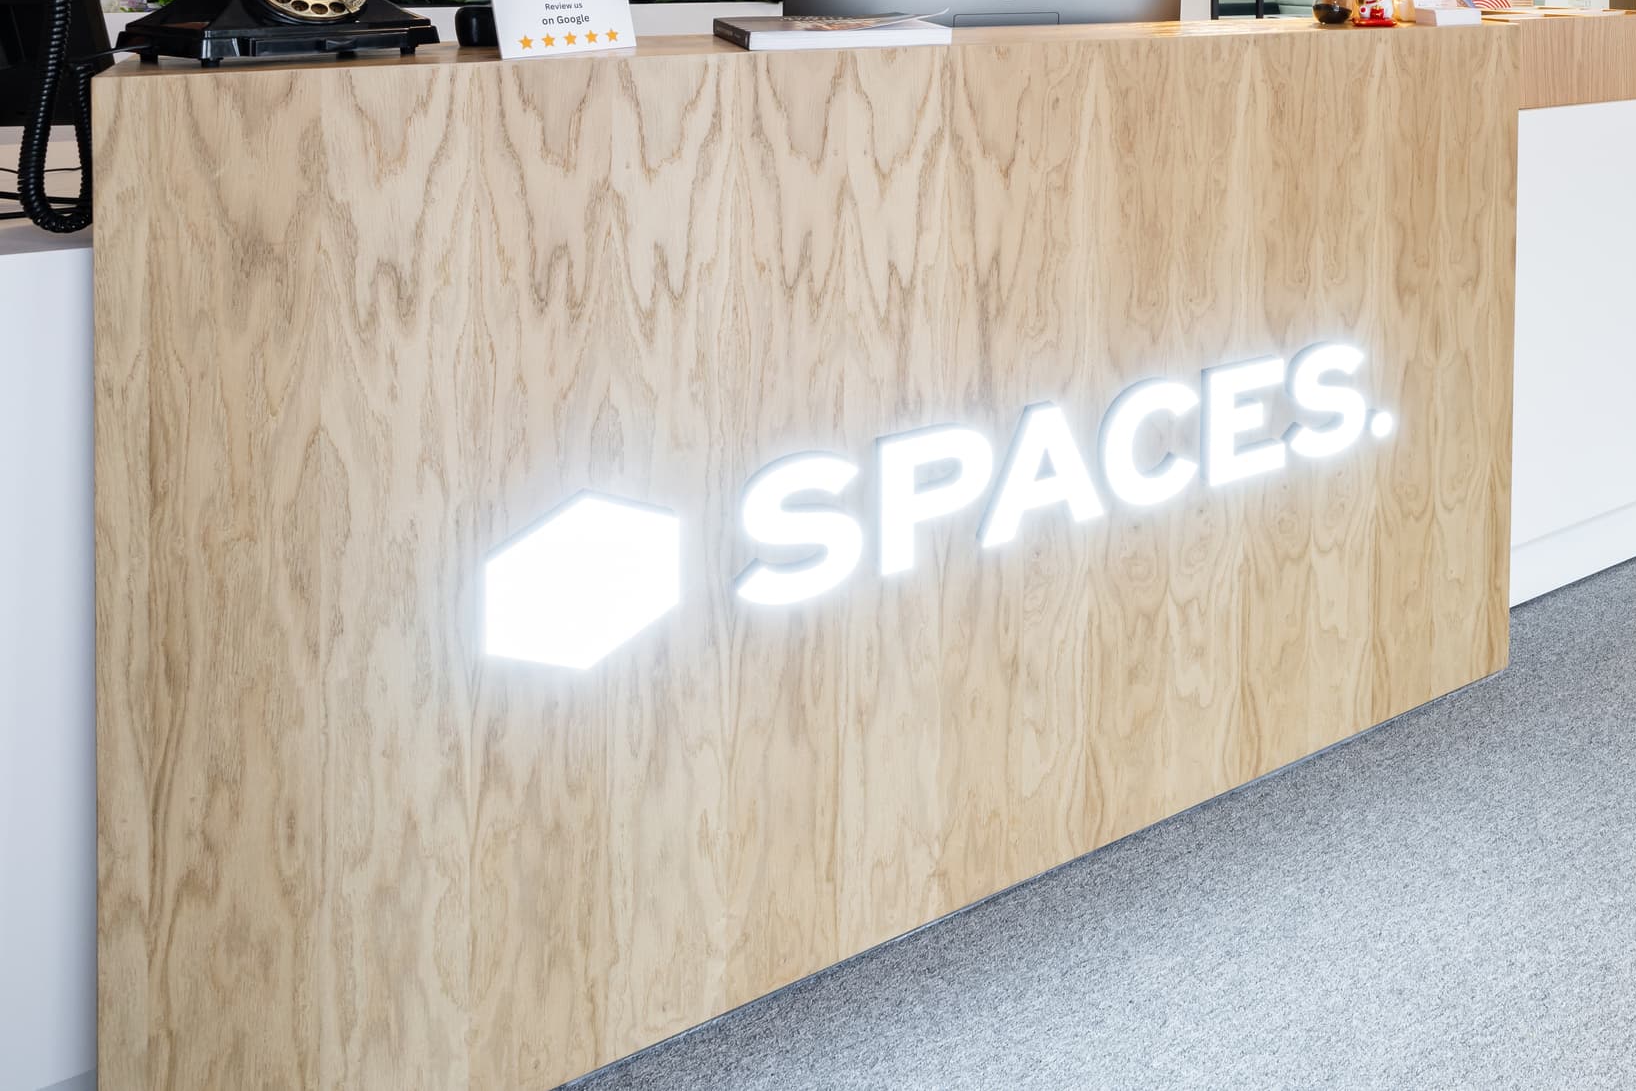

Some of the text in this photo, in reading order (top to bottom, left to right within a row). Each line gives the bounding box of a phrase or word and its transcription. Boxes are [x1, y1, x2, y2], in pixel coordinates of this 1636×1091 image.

[544, 2, 583, 11] Review us
[541, 13, 590, 27] on Google
[735, 340, 1396, 609] SPACES.
